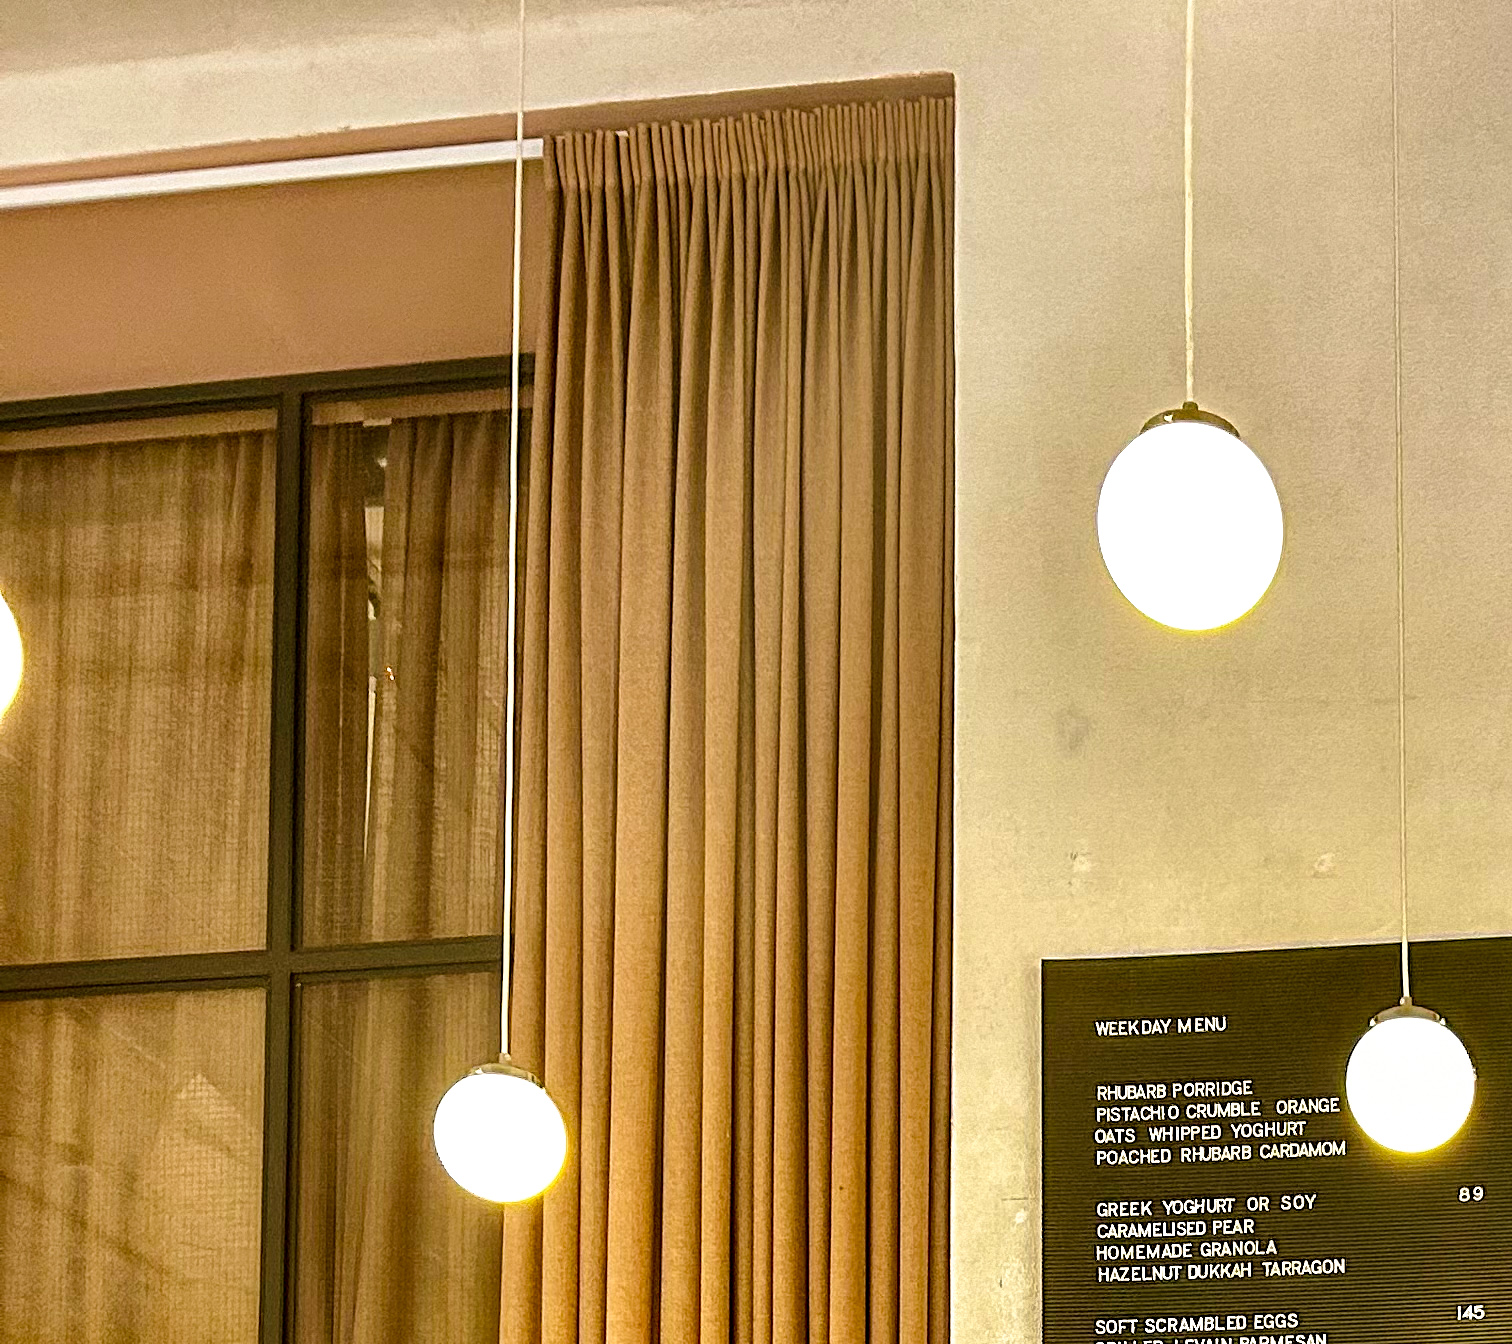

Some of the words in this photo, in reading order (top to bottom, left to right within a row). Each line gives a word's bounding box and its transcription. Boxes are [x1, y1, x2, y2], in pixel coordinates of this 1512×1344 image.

[1095, 1018, 1172, 1036] WEEKDAY
[1177, 1016, 1227, 1034] MENU
[1097, 1083, 1167, 1101] RHUBARB
[1172, 1080, 1253, 1099] PORRIDGE
[1096, 1105, 1180, 1123] PISTACHIO
[1185, 1101, 1262, 1119] CRUMBLE
[1276, 1097, 1341, 1115] ORANGE
[1094, 1128, 1136, 1144] OATS
[1148, 1124, 1222, 1142] WHIPPED
[1230, 1120, 1307, 1139] YOGHURT
[1096, 1148, 1172, 1166] POACHED
[1180, 1145, 1252, 1163] RHUBARB
[1259, 1140, 1346, 1159] CARDAMOM
[1458, 1186, 1484, 1202] 89
[1096, 1200, 1153, 1217] GREEK
[1161, 1197, 1236, 1216] YOGHURT
[1246, 1196, 1270, 1212] OR
[1280, 1194, 1317, 1211] SOY
[1097, 1220, 1207, 1239] CARAMELISED
[1212, 1218, 1255, 1236] PEAR
[1096, 1242, 1193, 1261] HOMEMADE
[1200, 1239, 1278, 1257] GRANOLA
[1098, 1265, 1183, 1283] HAZELNUT
[1187, 1262, 1252, 1280] DUKKAH
[1261, 1258, 1346, 1277] TARRAGON
[1094, 1318, 1139, 1335] SOFT
[1144, 1315, 1247, 1334] SCRAMBLED
[1253, 1312, 1299, 1330] EGGS
[1457, 1304, 1486, 1321] 145
